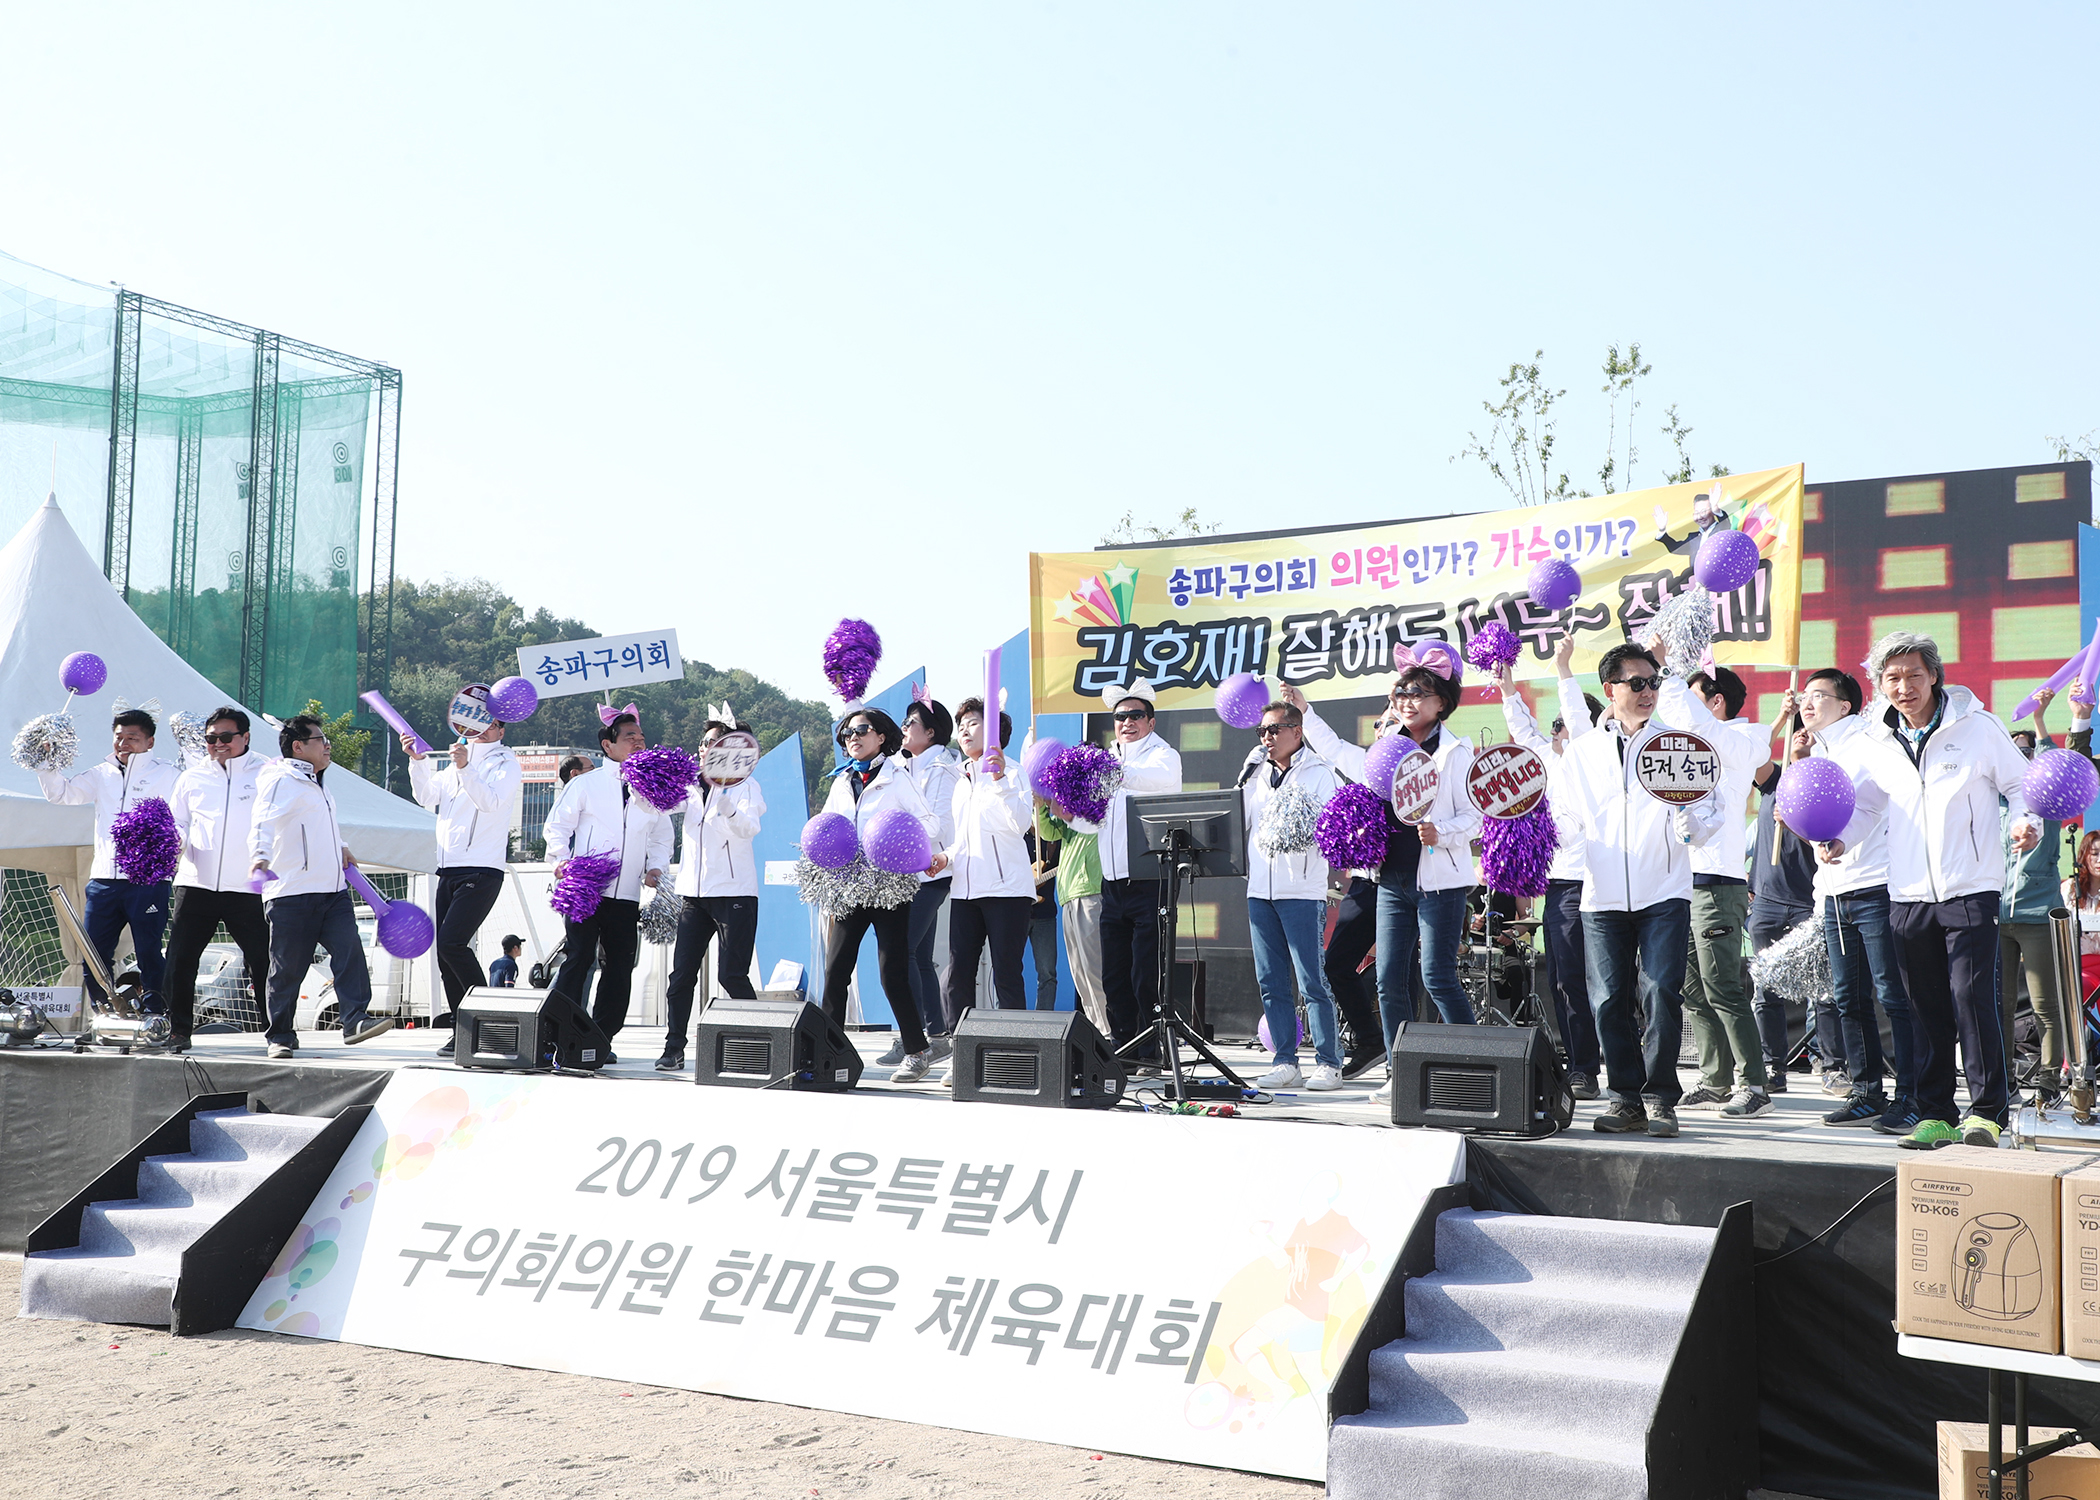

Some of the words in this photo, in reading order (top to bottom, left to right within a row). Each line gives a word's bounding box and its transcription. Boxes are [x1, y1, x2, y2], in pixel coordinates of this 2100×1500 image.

[1169, 558, 1317, 607] 송파구의회
[1330, 541, 1479, 590] 의원인가?
[1491, 519, 1636, 568] 가수인가?
[536, 640, 670, 686] 송파구의회
[1080, 623, 1265, 691] 김호재!
[1395, 768, 1438, 811] 희망입니다
[1472, 758, 1543, 811] 희망입니다
[1641, 754, 1676, 782] 무적
[1681, 754, 1717, 782] 송파
[575, 1136, 737, 1205] 2019
[744, 1148, 1084, 1245] 서울특별시
[1911, 1196, 1935, 1205] PREMIUM
[1936, 1199, 1960, 1207] AIRFRYER
[1911, 1203, 1959, 1217] YD-K06
[1921, 1183, 1961, 1193] AIRFRYER
[398, 1221, 693, 1316] 구의회의원
[699, 1249, 900, 1343] 한마음
[914, 1275, 1223, 1385] 체육대회
